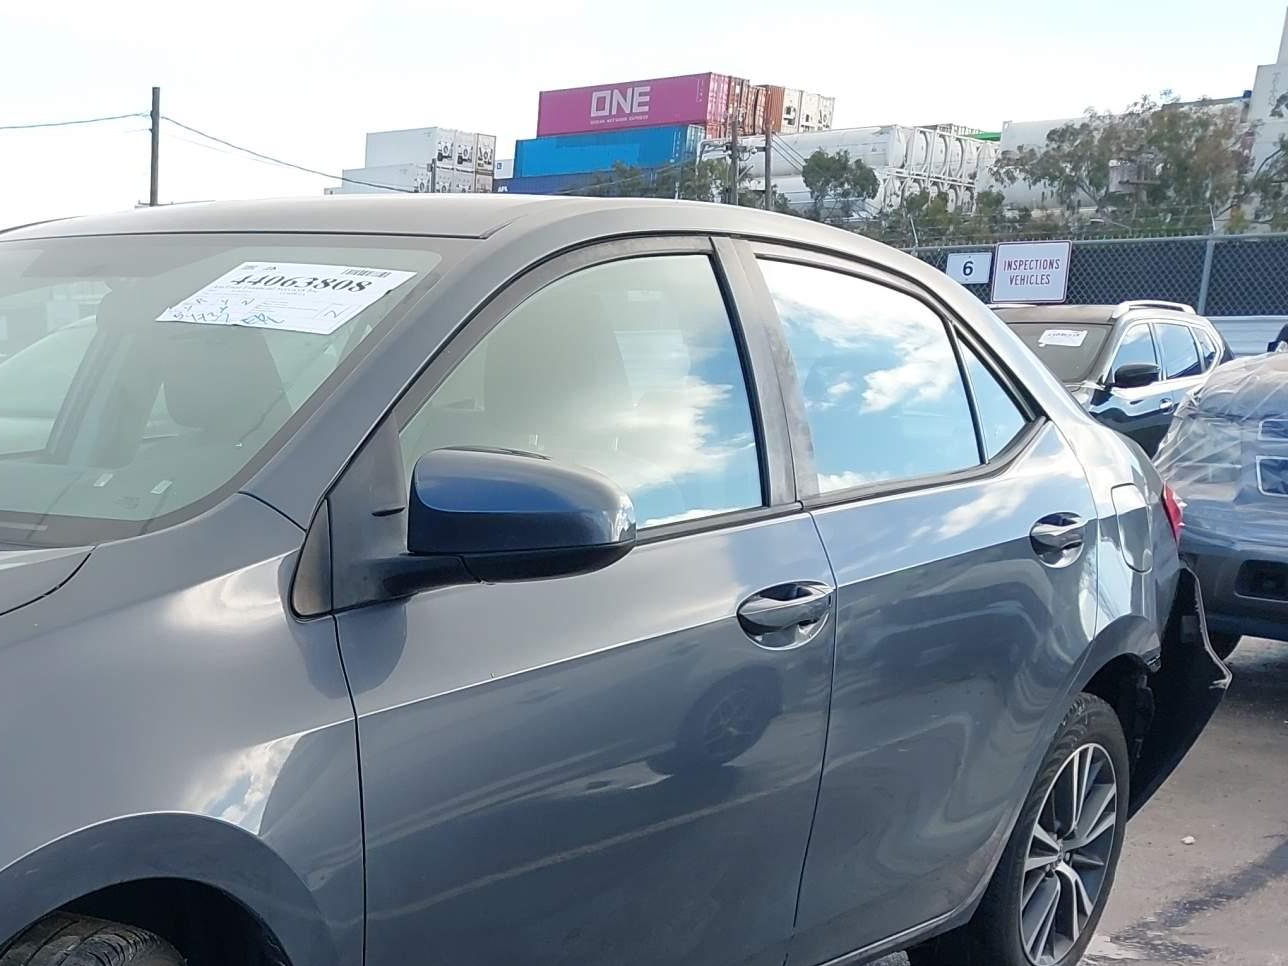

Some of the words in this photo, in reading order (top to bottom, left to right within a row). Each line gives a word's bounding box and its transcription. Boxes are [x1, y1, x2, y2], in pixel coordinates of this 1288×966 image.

[591, 86, 651, 117] ONE
[962, 260, 974, 277] 6
[1003, 258, 1061, 272] INSPECTIONS
[231, 274, 373, 293] 44063808
[1009, 273, 1052, 286] VEHICLES
